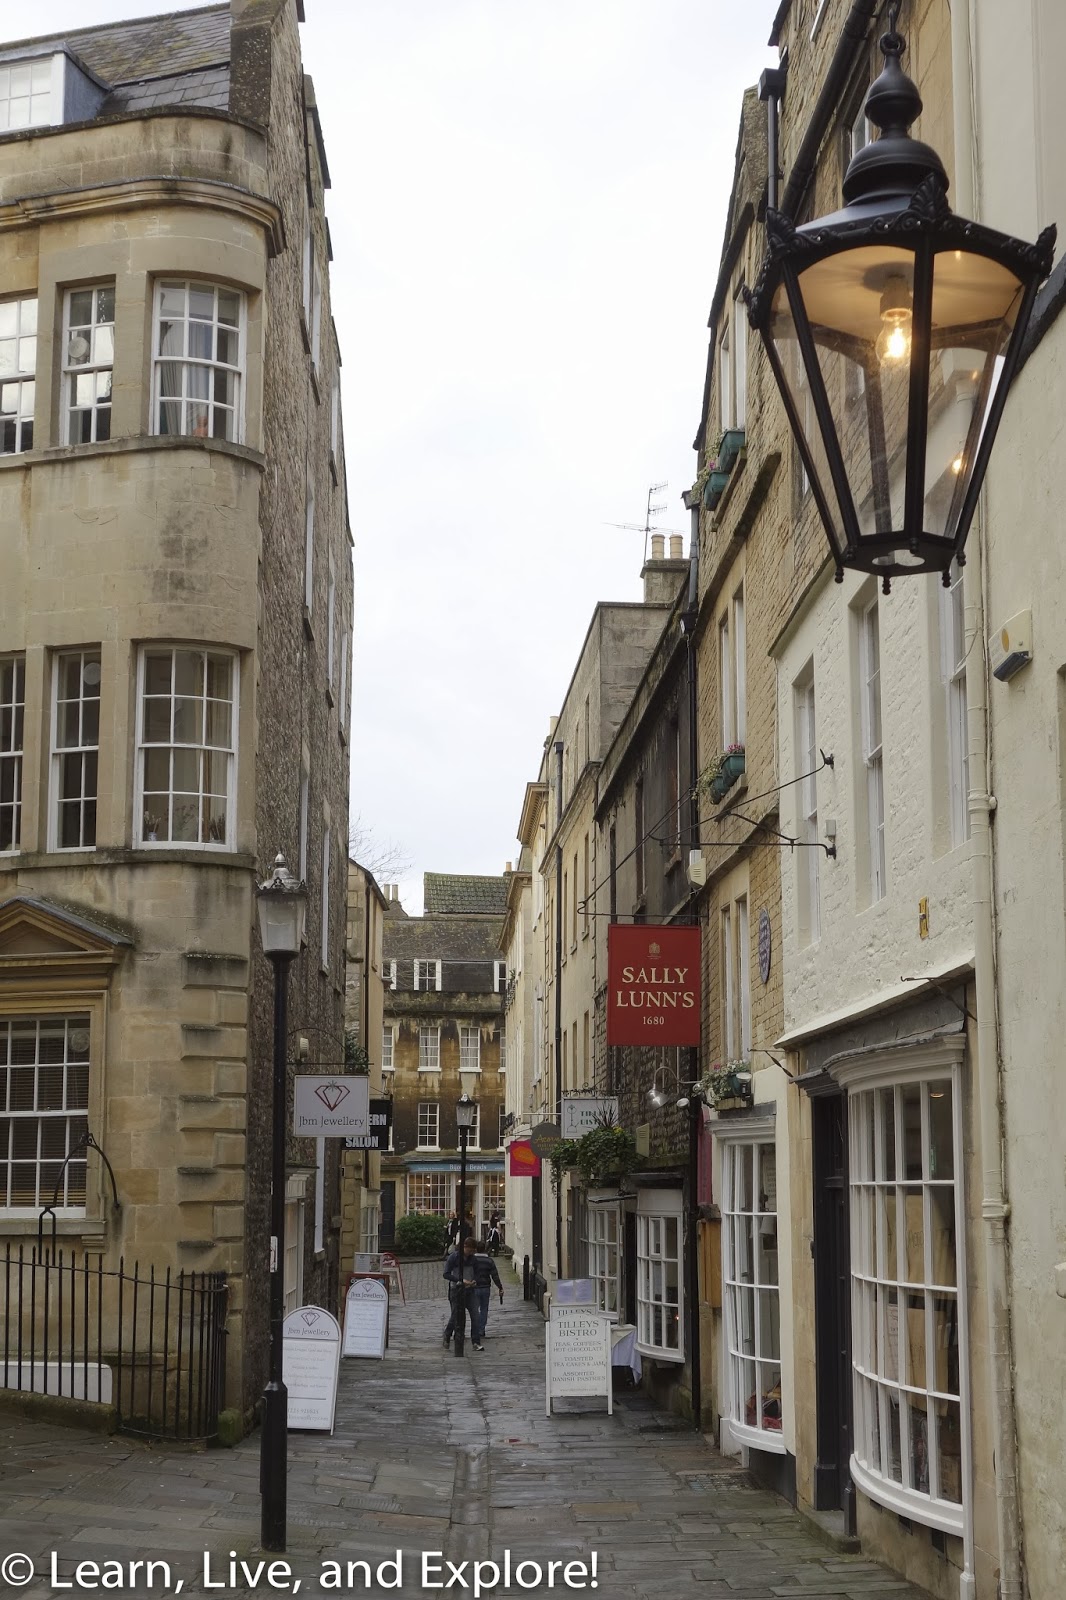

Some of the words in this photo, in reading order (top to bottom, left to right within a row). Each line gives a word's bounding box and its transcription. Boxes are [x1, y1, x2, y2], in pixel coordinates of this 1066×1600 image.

[621, 966, 689, 984] SALLY
[616, 990, 695, 1008] LUNN'S
[642, 1015, 665, 1025] 1680
[299, 1116, 318, 1127] Jbm
[320, 1116, 365, 1128] Jewellery
[345, 1135, 379, 1148] SALON
[469, 1163, 487, 1171] Beads
[557, 1320, 599, 1329] TILLEYS
[301, 1327, 331, 1336] Jewellery
[559, 1329, 597, 1337] BISTRO
